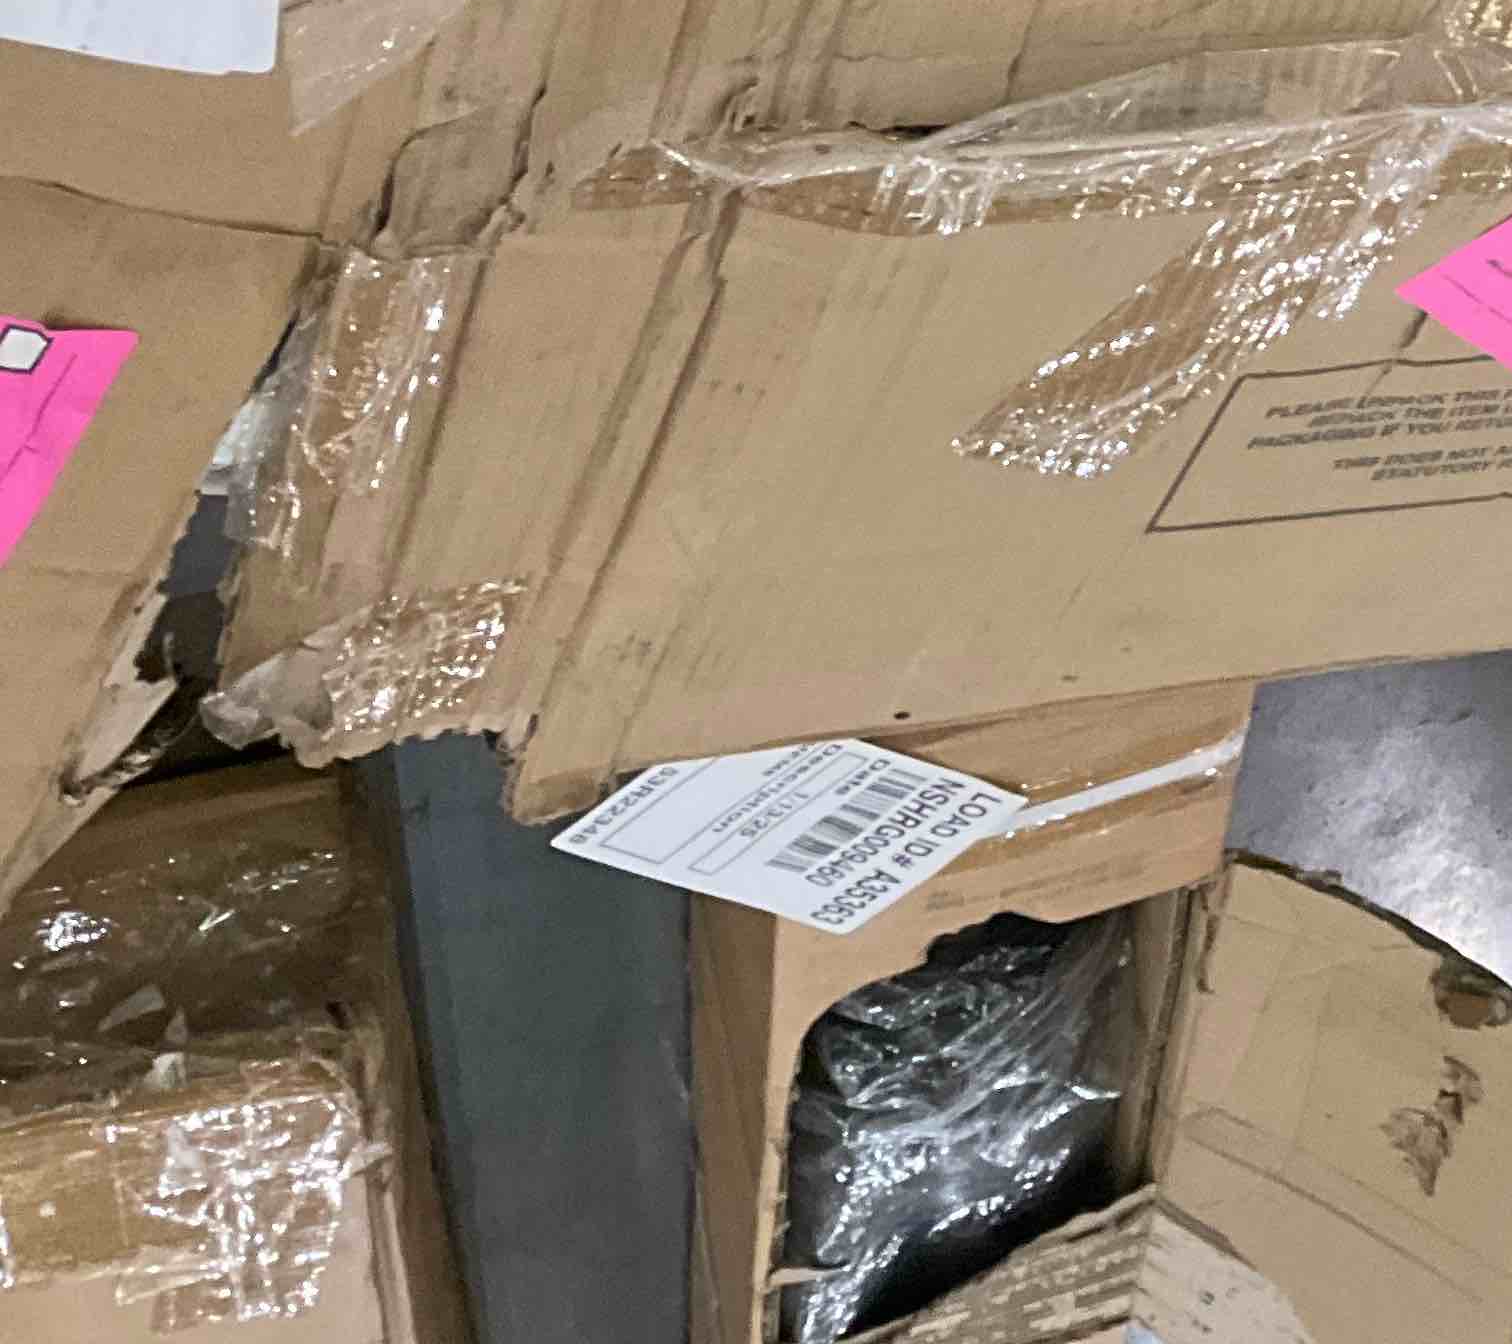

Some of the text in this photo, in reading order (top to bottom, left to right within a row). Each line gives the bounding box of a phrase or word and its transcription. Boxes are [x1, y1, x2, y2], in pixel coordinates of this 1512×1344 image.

[1264, 397, 1356, 419] PLEASE
[1454, 389, 1501, 403] THIS
[1403, 406, 1448, 420] THE
[1246, 426, 1377, 451] PACKAGING
[1405, 420, 1453, 437] YOU
[1331, 455, 1381, 471] THIS
[1382, 449, 1445, 466] DOES
[1445, 445, 1491, 462] NOT
[1369, 461, 1491, 481] STATUTORY
[712, 743, 844, 833] Description
[834, 758, 891, 795] Date
[930, 791, 1003, 838] LOAD
[804, 777, 966, 888] NSHRG009460
[892, 837, 941, 870] ID#
[810, 868, 903, 926] A35363
